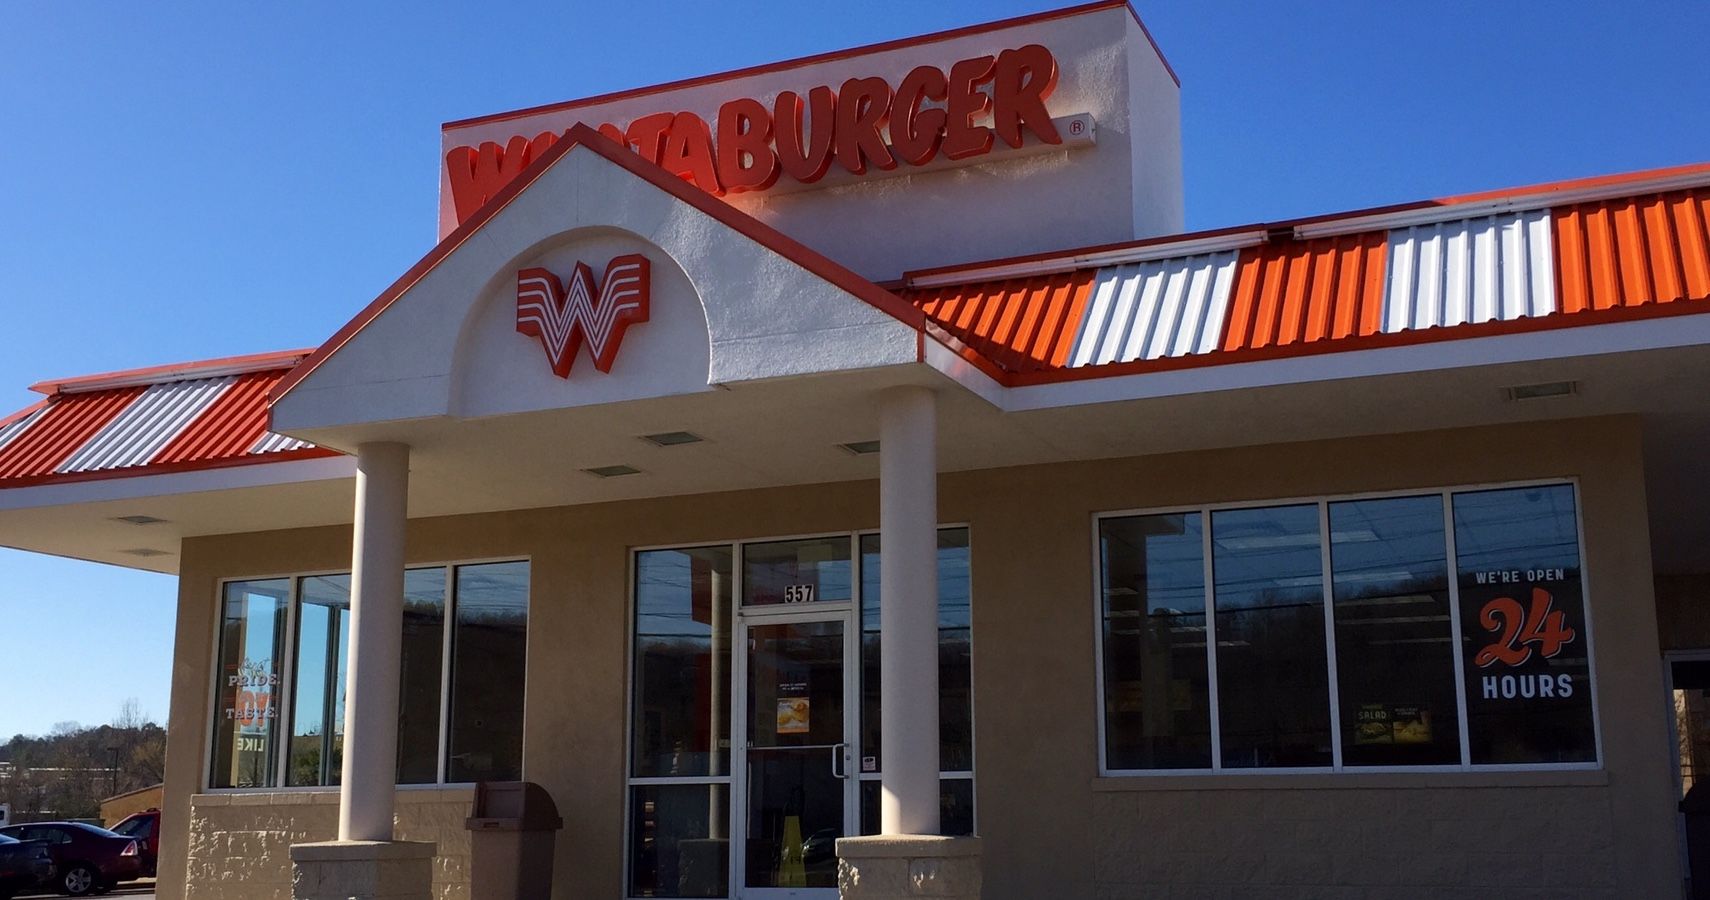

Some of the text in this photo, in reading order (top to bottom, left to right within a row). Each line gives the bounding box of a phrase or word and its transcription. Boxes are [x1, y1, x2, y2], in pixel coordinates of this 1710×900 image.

[446, 43, 1063, 227] WTABURGER
[516, 253, 651, 380] W
[786, 585, 813, 602] 557
[1475, 568, 1565, 584] WE'RE OPEN
[1474, 587, 1576, 668] 24
[1482, 673, 1573, 700] HOURS
